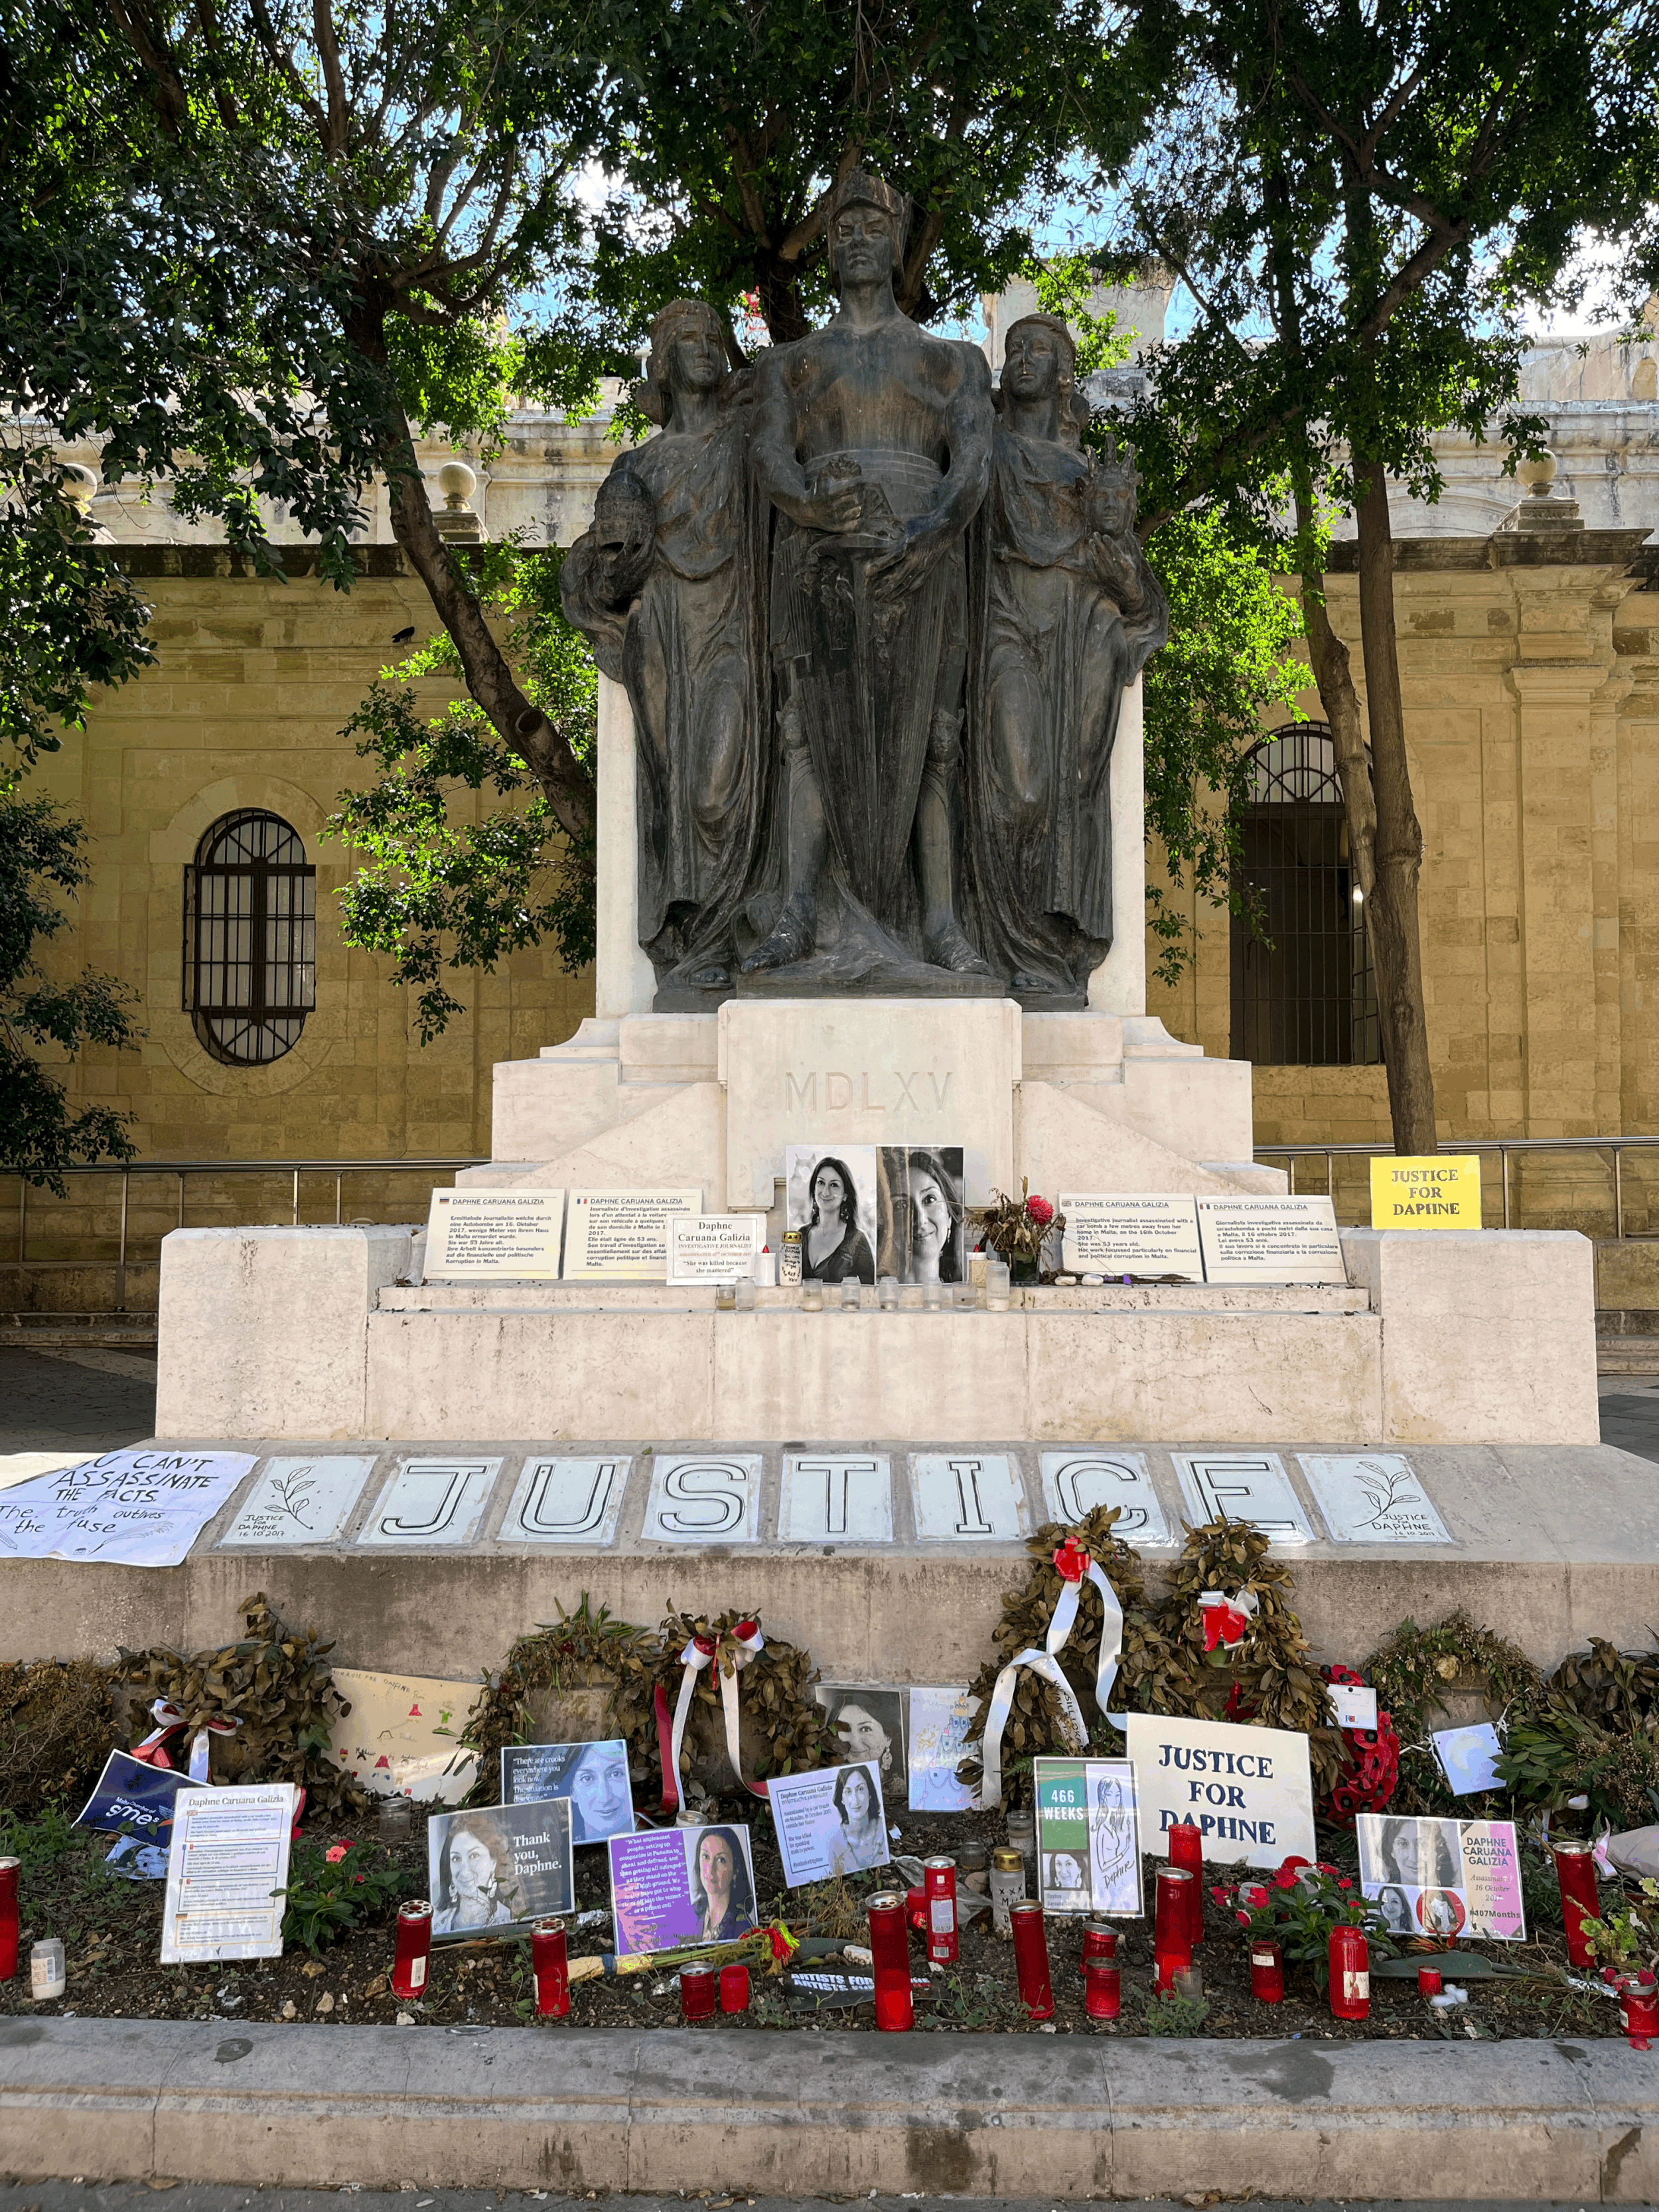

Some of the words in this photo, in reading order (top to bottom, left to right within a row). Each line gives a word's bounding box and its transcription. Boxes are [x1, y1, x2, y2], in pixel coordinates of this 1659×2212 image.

[786, 1072, 953, 1112] MDLXV
[1392, 1169, 1459, 1183] JUSTICE
[1409, 1187, 1442, 1199] FOR
[1393, 1203, 1460, 1215] DAPHNE
[699, 1222, 732, 1230] Daphne
[132, 1455, 214, 1472] CAN'T
[48, 1471, 219, 1489] ASSASSINATE
[55, 1488, 86, 1501] THE
[100, 1489, 160, 1503] FACTS.
[380, 1460, 1300, 1536] JUSTICE
[56, 1505, 98, 1518] truth
[14, 1519, 45, 1534] the
[67, 1517, 117, 1534] fuse
[1159, 1744, 1273, 1779] JUSTICE
[513, 1765, 547, 1776] everywhere
[513, 1775, 526, 1783] look
[115, 1797, 129, 1805] Malta
[1051, 1789, 1075, 1803] 466
[1188, 1780, 1247, 1809] FOR
[1043, 1806, 1084, 1820] WEEKS
[514, 1832, 551, 1847] Thank
[1467, 1837, 1506, 1847] DAPHNE
[514, 1850, 539, 1864] you,
[1463, 1847, 1512, 1857] CARUANA
[514, 1860, 562, 1876] Daphne.
[1469, 1856, 1509, 1866] GALIZIA
[1470, 1910, 1520, 1919] #107Months
[791, 1973, 845, 1984] ARTISTS
[848, 1976, 875, 1985] FOR
